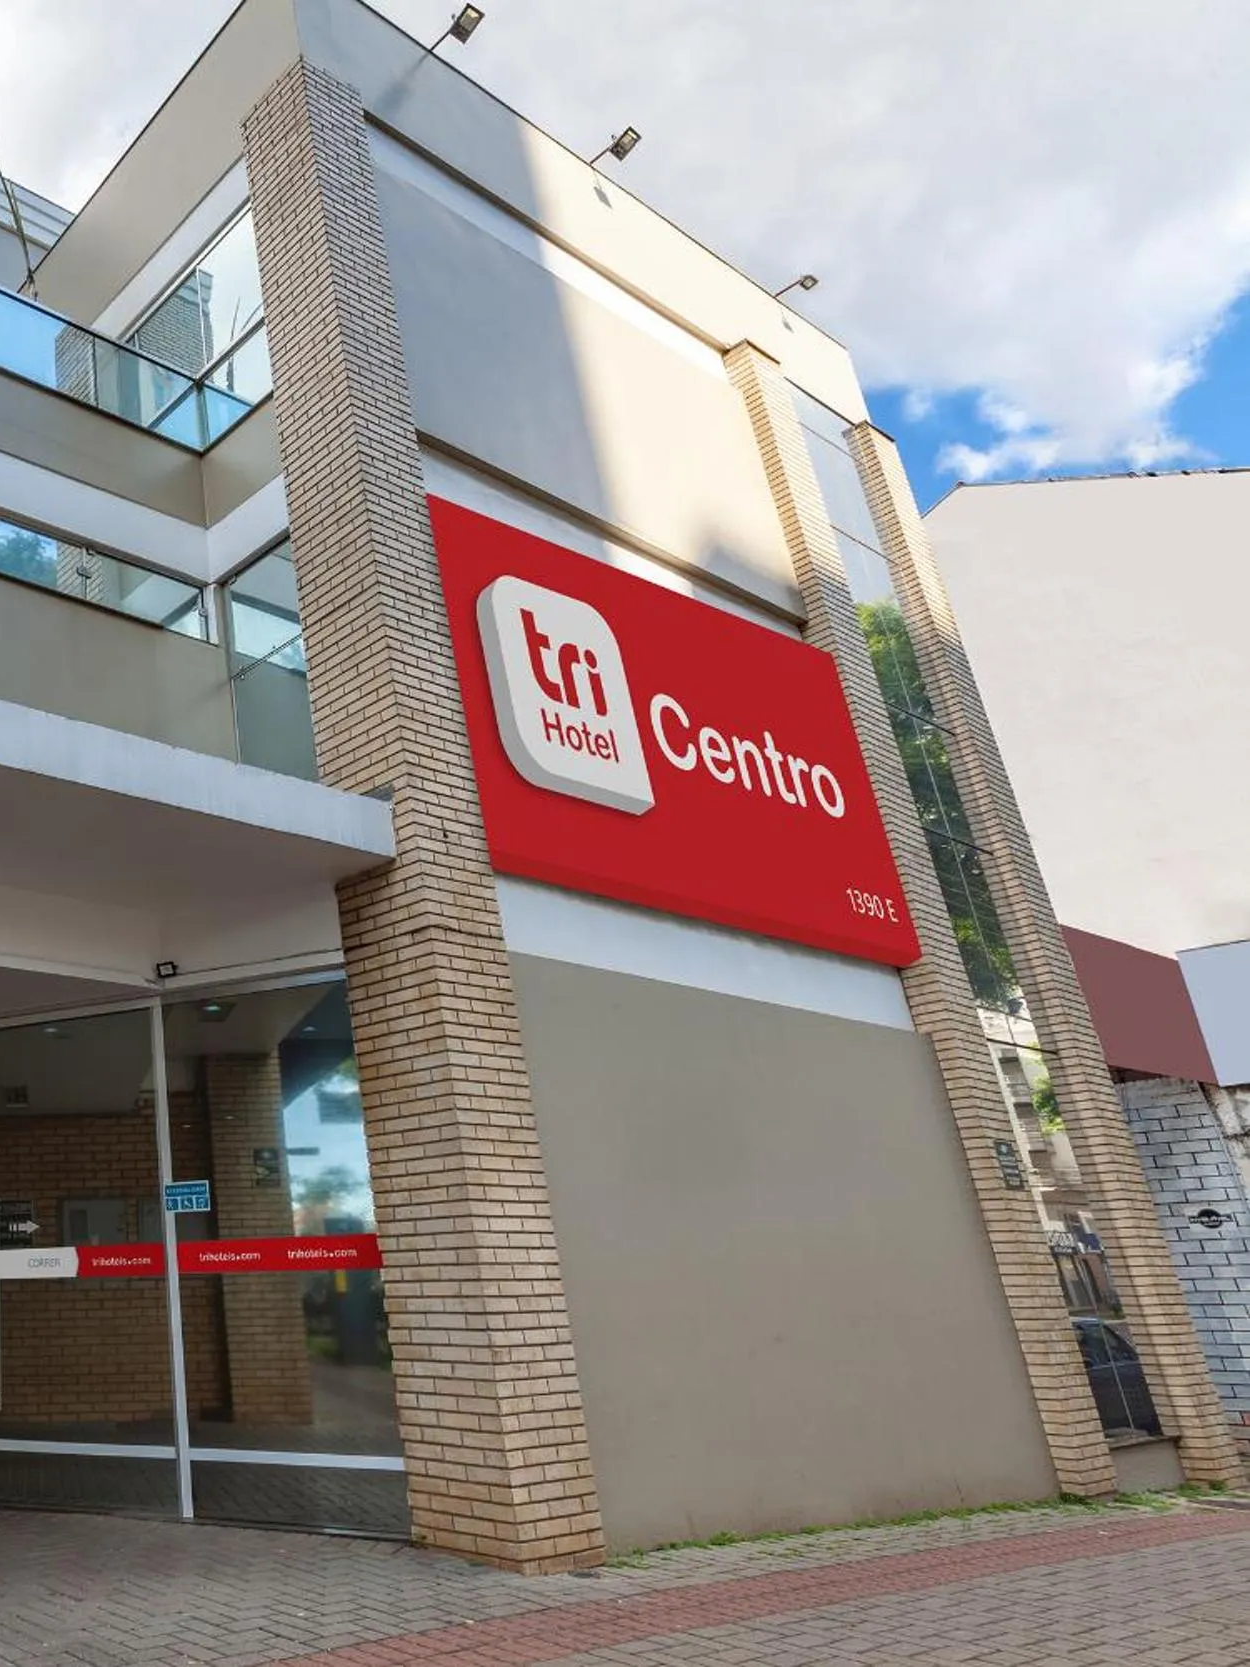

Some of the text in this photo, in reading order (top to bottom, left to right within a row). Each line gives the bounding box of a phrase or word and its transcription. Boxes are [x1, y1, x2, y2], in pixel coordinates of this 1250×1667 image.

[520, 608, 607, 716] tri
[541, 708, 620, 763] Hotel
[650, 693, 845, 818] Centro
[846, 888, 899, 922] 1390 E
